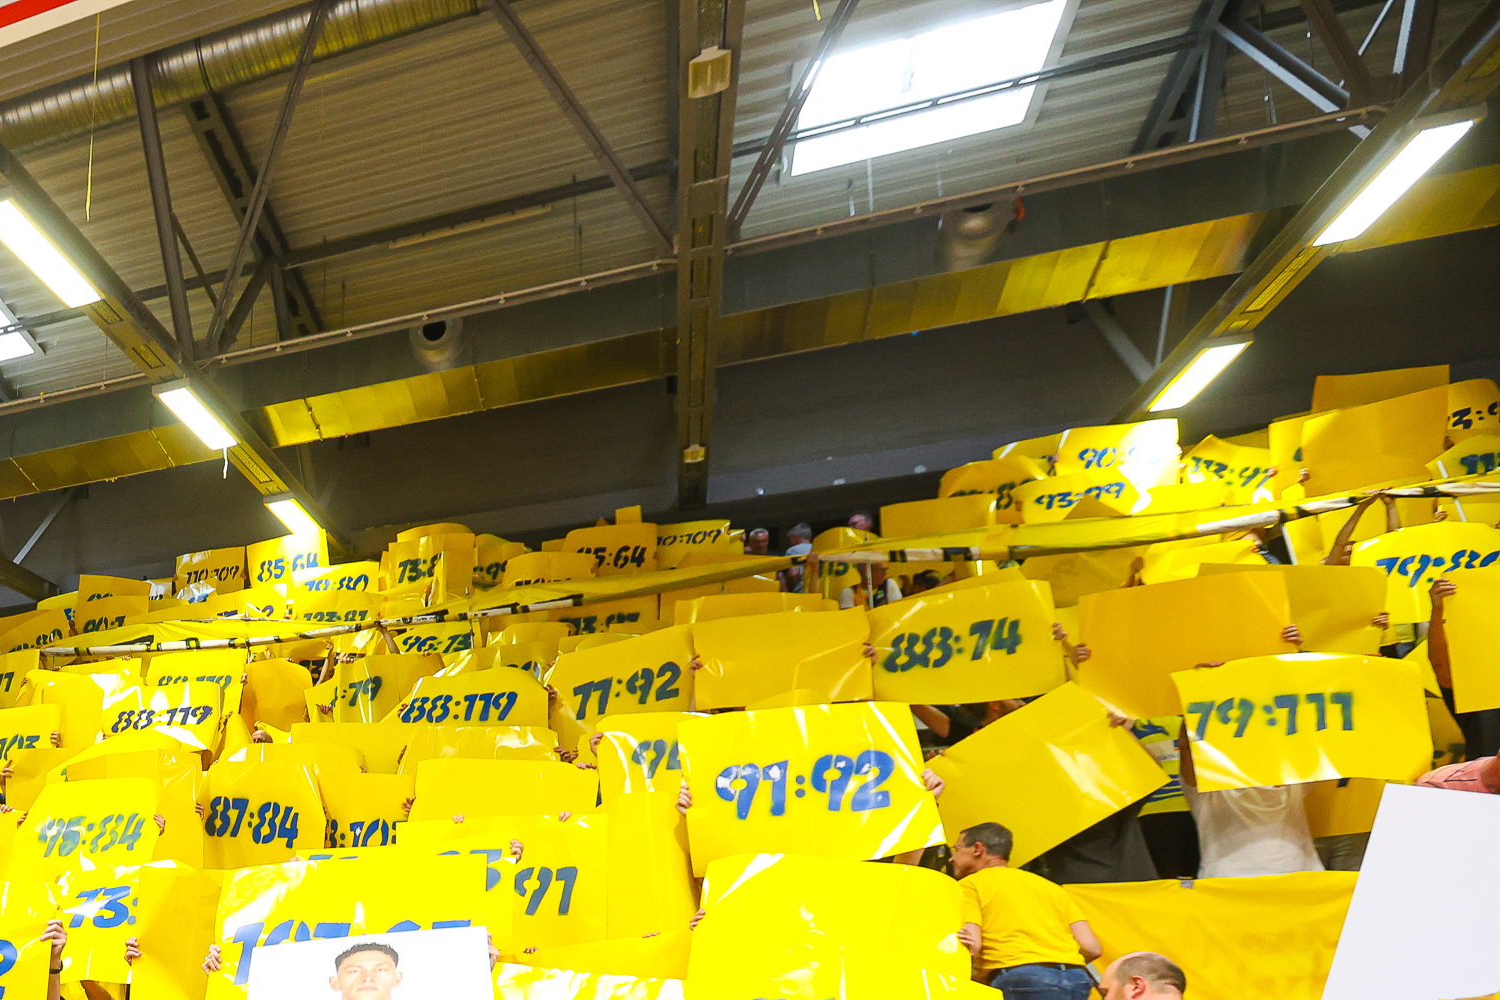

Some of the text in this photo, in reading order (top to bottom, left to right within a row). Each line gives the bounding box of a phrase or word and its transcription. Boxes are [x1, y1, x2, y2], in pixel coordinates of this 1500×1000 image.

[884, 617, 1021, 673] 88:74
[401, 690, 517, 723] 88:119
[574, 661, 681, 720] 77:92
[1187, 691, 1354, 741] 79:111
[112, 705, 212, 733] 88:119
[716, 750, 895, 820] 91:92
[37, 812, 146, 858] 95:84
[205, 797, 298, 849] 87:84
